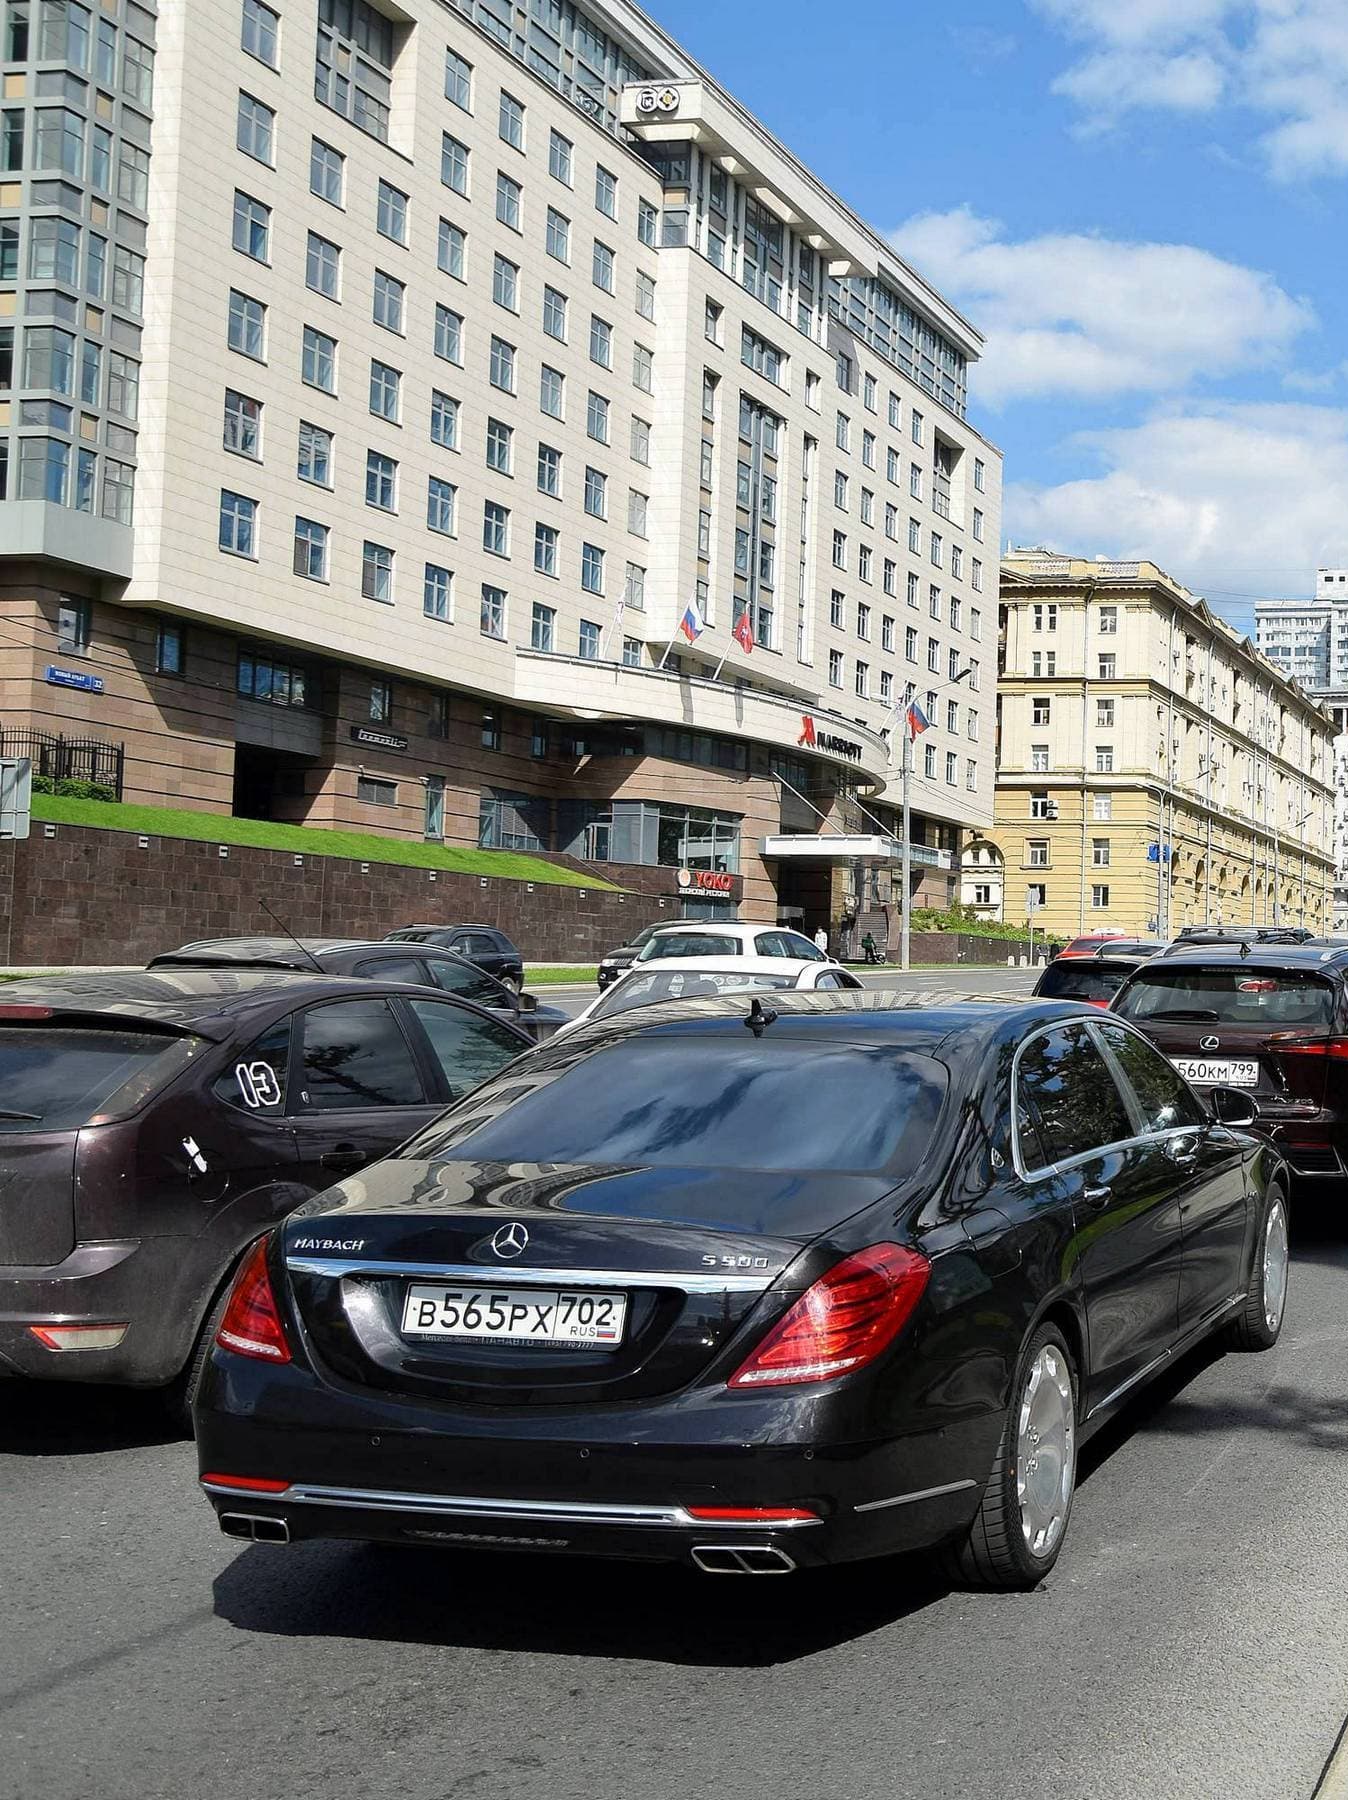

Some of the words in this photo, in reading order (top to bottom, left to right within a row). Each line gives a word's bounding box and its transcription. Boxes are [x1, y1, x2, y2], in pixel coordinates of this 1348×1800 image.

[694, 870, 735, 890] YOKO
[1178, 1062, 1228, 1079] 560КМ
[1231, 1063, 1254, 1075] 799
[236, 1062, 281, 1107] 13
[294, 1239, 365, 1250] MAYBACH
[701, 1254, 717, 1266] S
[720, 1255, 769, 1269] 500
[561, 1296, 614, 1326] 702
[570, 1326, 597, 1337] RUS
